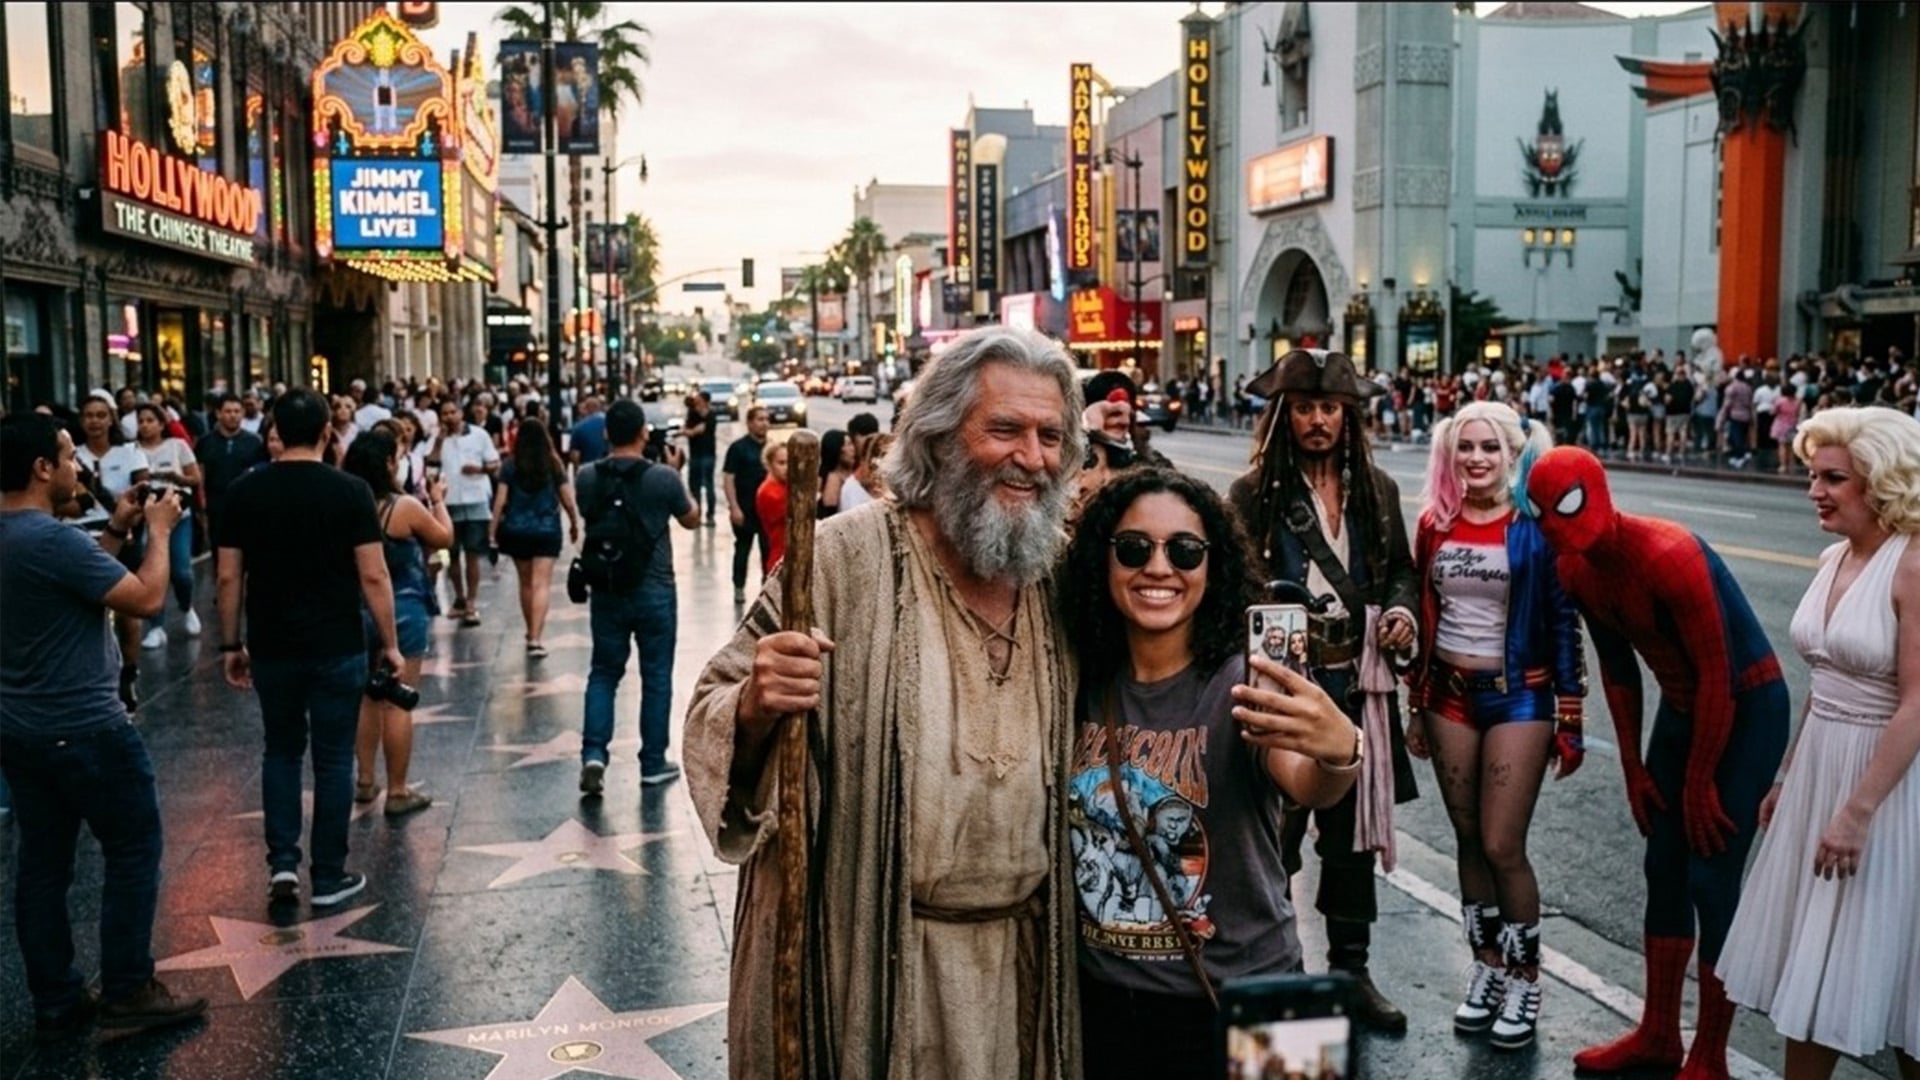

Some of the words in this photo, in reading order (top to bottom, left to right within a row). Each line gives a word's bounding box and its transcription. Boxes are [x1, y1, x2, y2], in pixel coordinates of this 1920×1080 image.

[1187, 39, 1208, 251] HOLLYWOOD
[107, 130, 261, 234] HOLLYWOOD
[350, 168, 423, 188] JIMMY
[340, 190, 437, 215] KIMMEL
[115, 202, 147, 234] THE
[151, 212, 206, 250] CHINESE
[467, 1023, 570, 1045] MARILYN
[578, 1014, 674, 1034] MONROE
